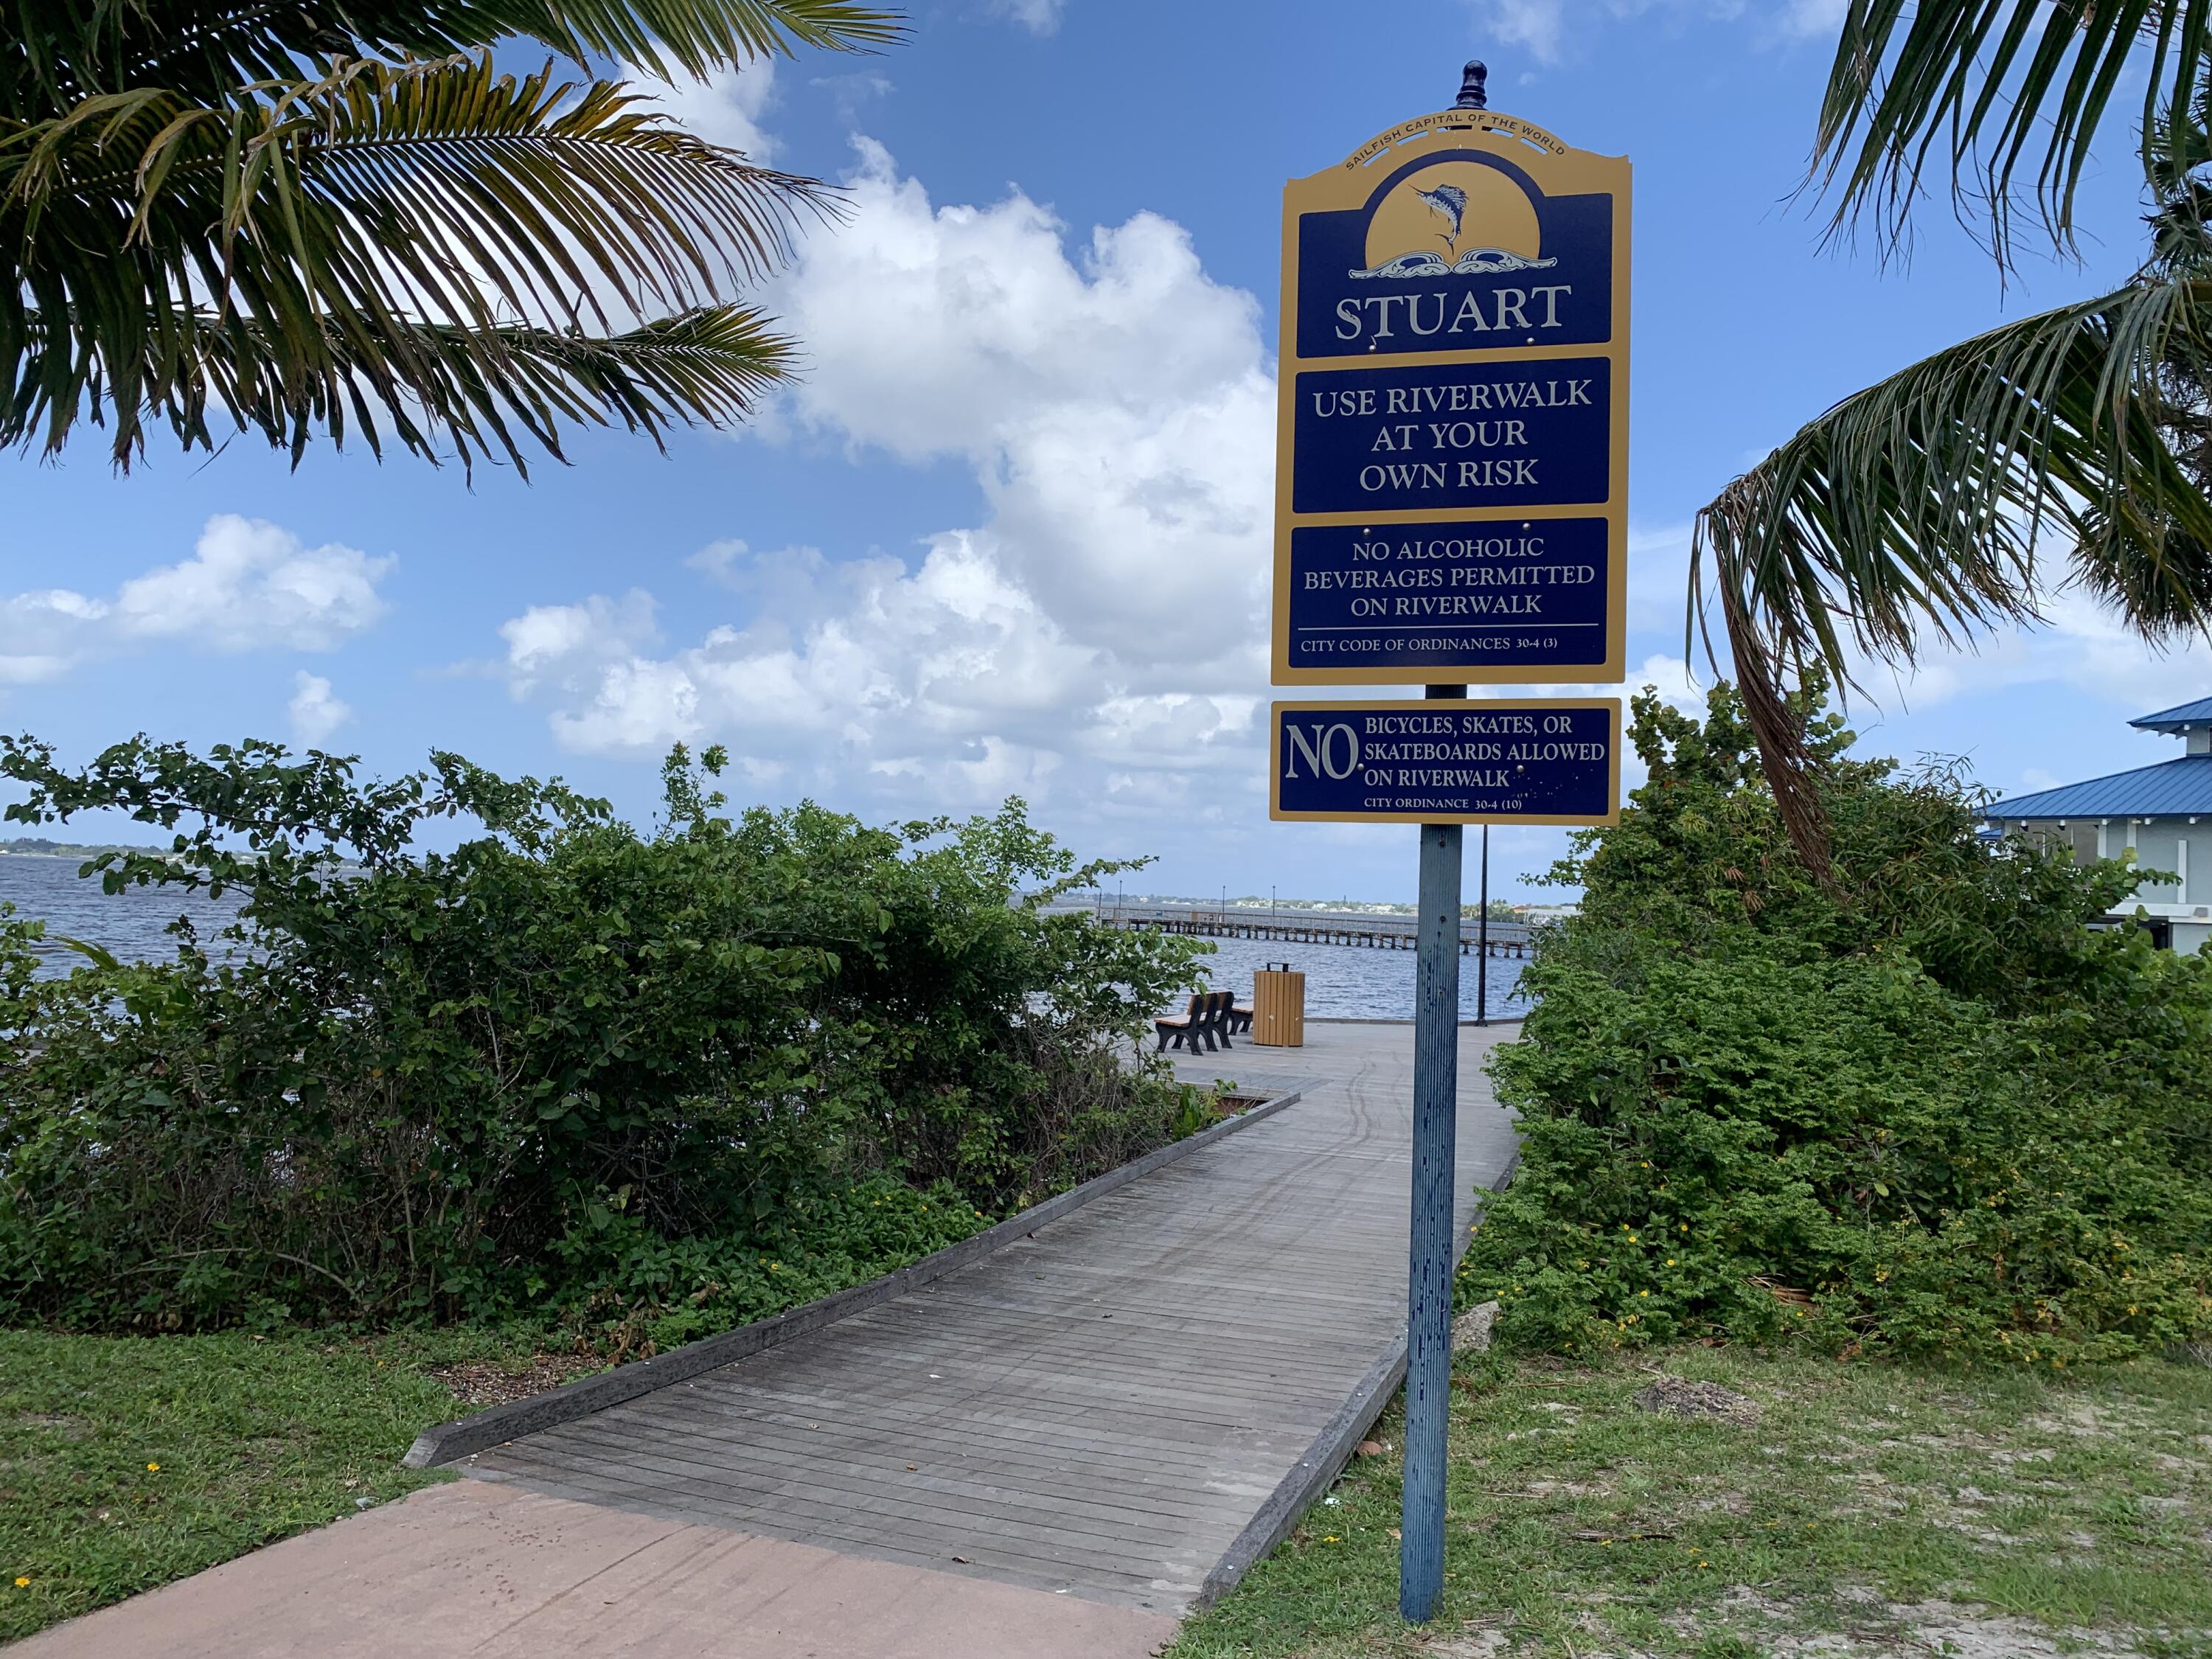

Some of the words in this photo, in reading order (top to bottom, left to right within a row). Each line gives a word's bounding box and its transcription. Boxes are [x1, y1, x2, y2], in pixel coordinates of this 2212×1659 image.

[1346, 130, 1402, 171] SAILFISH
[1405, 114, 1463, 133] CAPITAL
[1468, 114, 1486, 122] OF
[1492, 116, 1518, 131] THE
[1522, 125, 1565, 156] WORLD
[1335, 285, 1572, 341] STUART
[1312, 389, 1377, 417] USE
[1386, 378, 1593, 414] RIVERWALK
[1371, 424, 1419, 452] AT
[1427, 419, 1528, 450] YOUR
[1359, 462, 1446, 492] OWN
[1457, 458, 1540, 488] RISK
[1352, 541, 1390, 561] NO
[1396, 537, 1545, 560] ALCOHOLIC
[1304, 568, 1443, 591] BEVERAGES
[1450, 565, 1596, 587] PERMITTED
[1350, 597, 1388, 616] ON
[1395, 594, 1542, 616] RIVERWALK
[1301, 639, 1336, 653] CITY
[1339, 639, 1381, 652] CODE
[1385, 639, 1405, 651] OF
[1408, 637, 1511, 651] ORDINANCES
[1516, 638, 1540, 649] 30-4
[1543, 637, 1558, 650] (3)
[1365, 716, 1458, 738] BICYCLES,
[1462, 715, 1538, 737] SKATES,
[1543, 715, 1573, 734] OR
[1285, 723, 1360, 780] NO
[1364, 742, 1502, 761] SKATEBOARDS
[1506, 742, 1605, 761] ALLOWED
[1364, 769, 1395, 787] ON
[1398, 769, 1510, 787] RIVERWALK
[1364, 797, 1393, 808] CITY
[1395, 798, 1470, 809] ORDINANCE
[1475, 799, 1498, 810] 30-4
[1501, 799, 1523, 811] (10)
